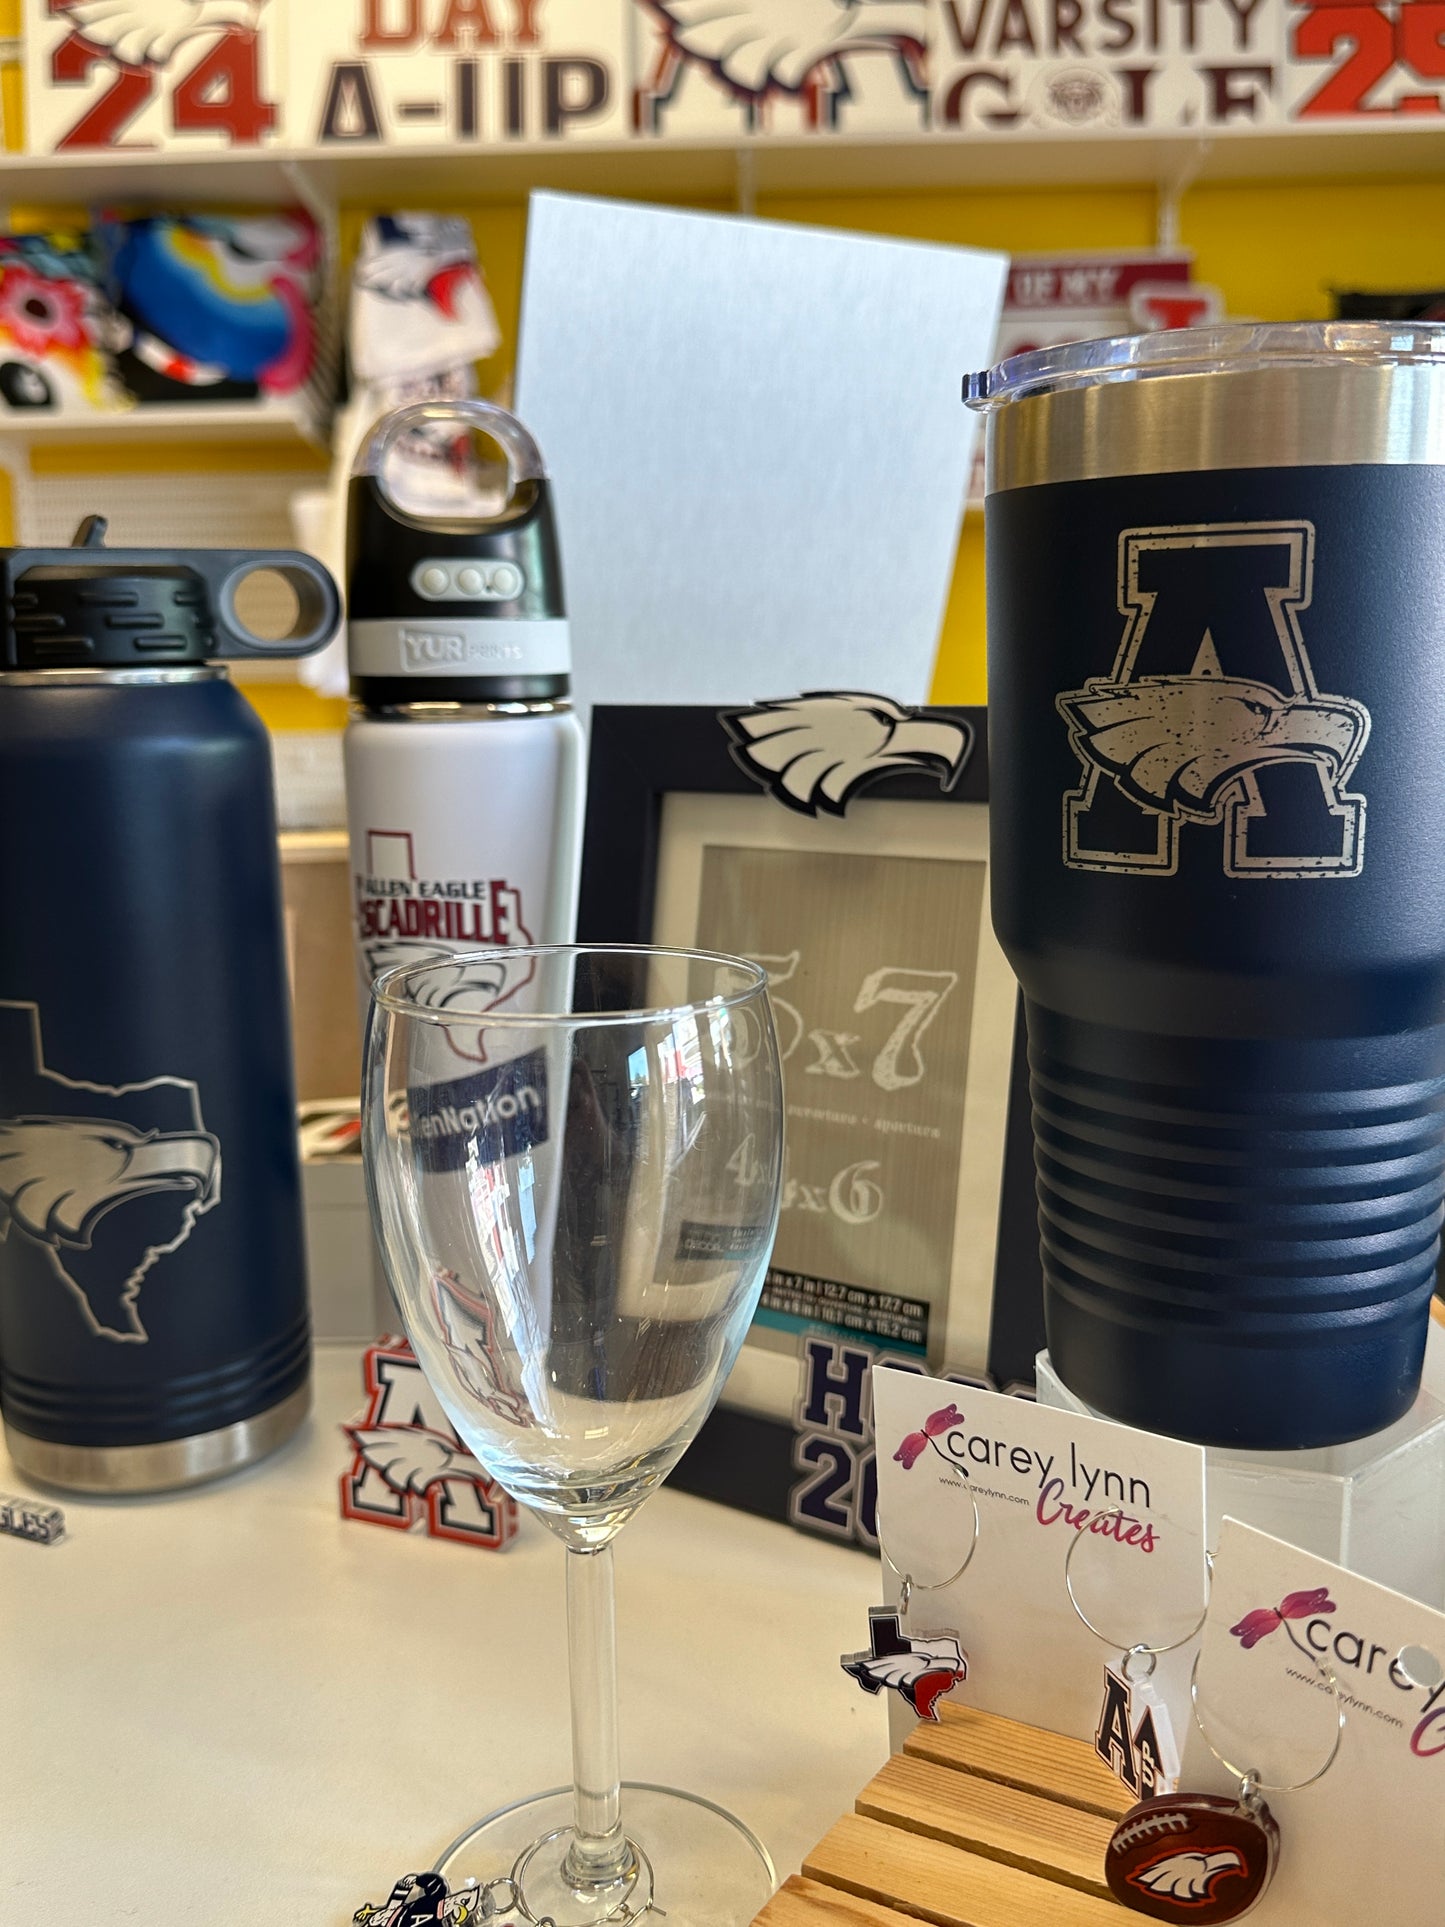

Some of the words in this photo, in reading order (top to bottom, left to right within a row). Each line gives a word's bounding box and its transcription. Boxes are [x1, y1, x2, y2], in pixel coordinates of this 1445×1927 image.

[942, 0, 1264, 56] VARSITY
[404, 633, 464, 662] YUR
[418, 879, 487, 901] EAGLE
[947, 1430, 1055, 1490] carey
[1070, 1441, 1151, 1509] lynn
[1036, 1477, 1162, 1554] Creates
